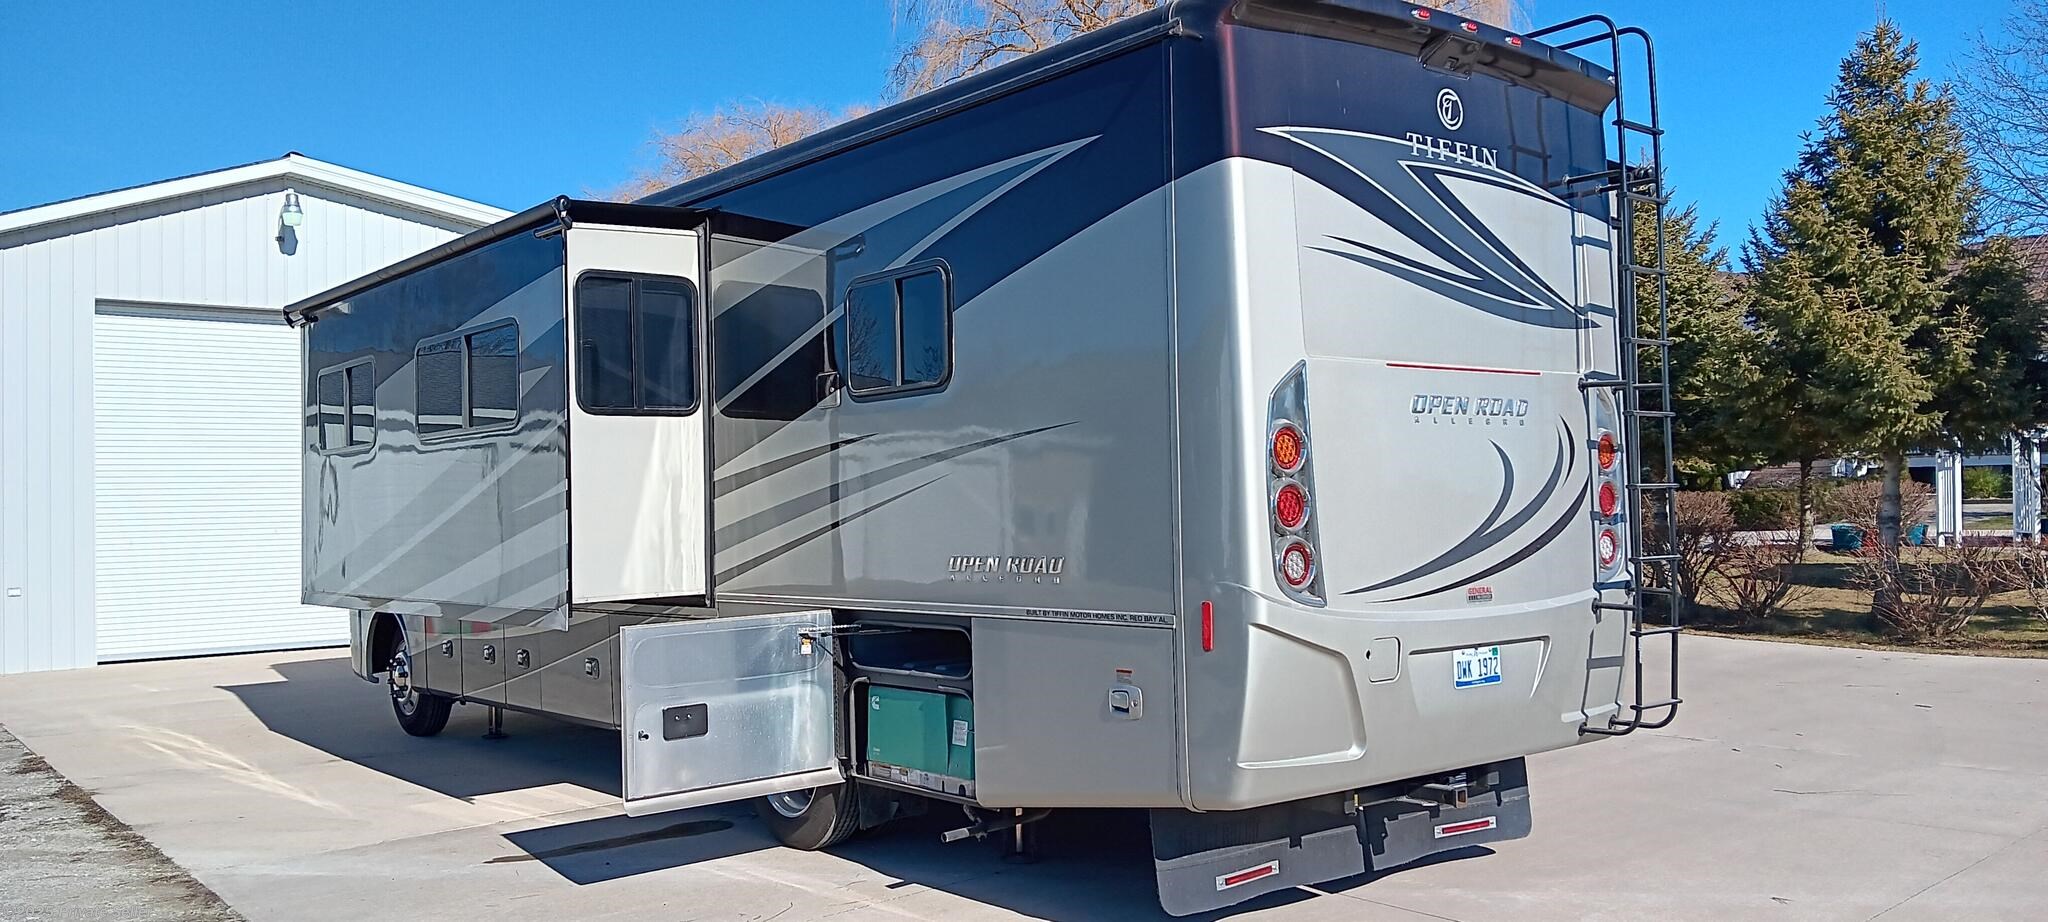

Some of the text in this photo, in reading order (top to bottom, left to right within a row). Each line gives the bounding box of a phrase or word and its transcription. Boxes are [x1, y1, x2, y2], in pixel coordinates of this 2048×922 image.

[1406, 132, 1498, 169] TIFFIN
[1411, 394, 1529, 417] OPEN ROAD
[1414, 416, 1525, 426] ALLEGRO
[948, 555, 1065, 575] OPEN ROAD
[1468, 587, 1493, 595] GENERAL
[1026, 608, 1042, 616] BUILT
[1043, 609, 1050, 617] BY
[1051, 610, 1069, 618] TIFFIN
[1070, 611, 1092, 619] MOTOR
[1092, 612, 1116, 620] HOMES
[1129, 614, 1143, 622] RED
[1144, 615, 1157, 623] BAY
[1456, 656, 1499, 680] DWK 1972
